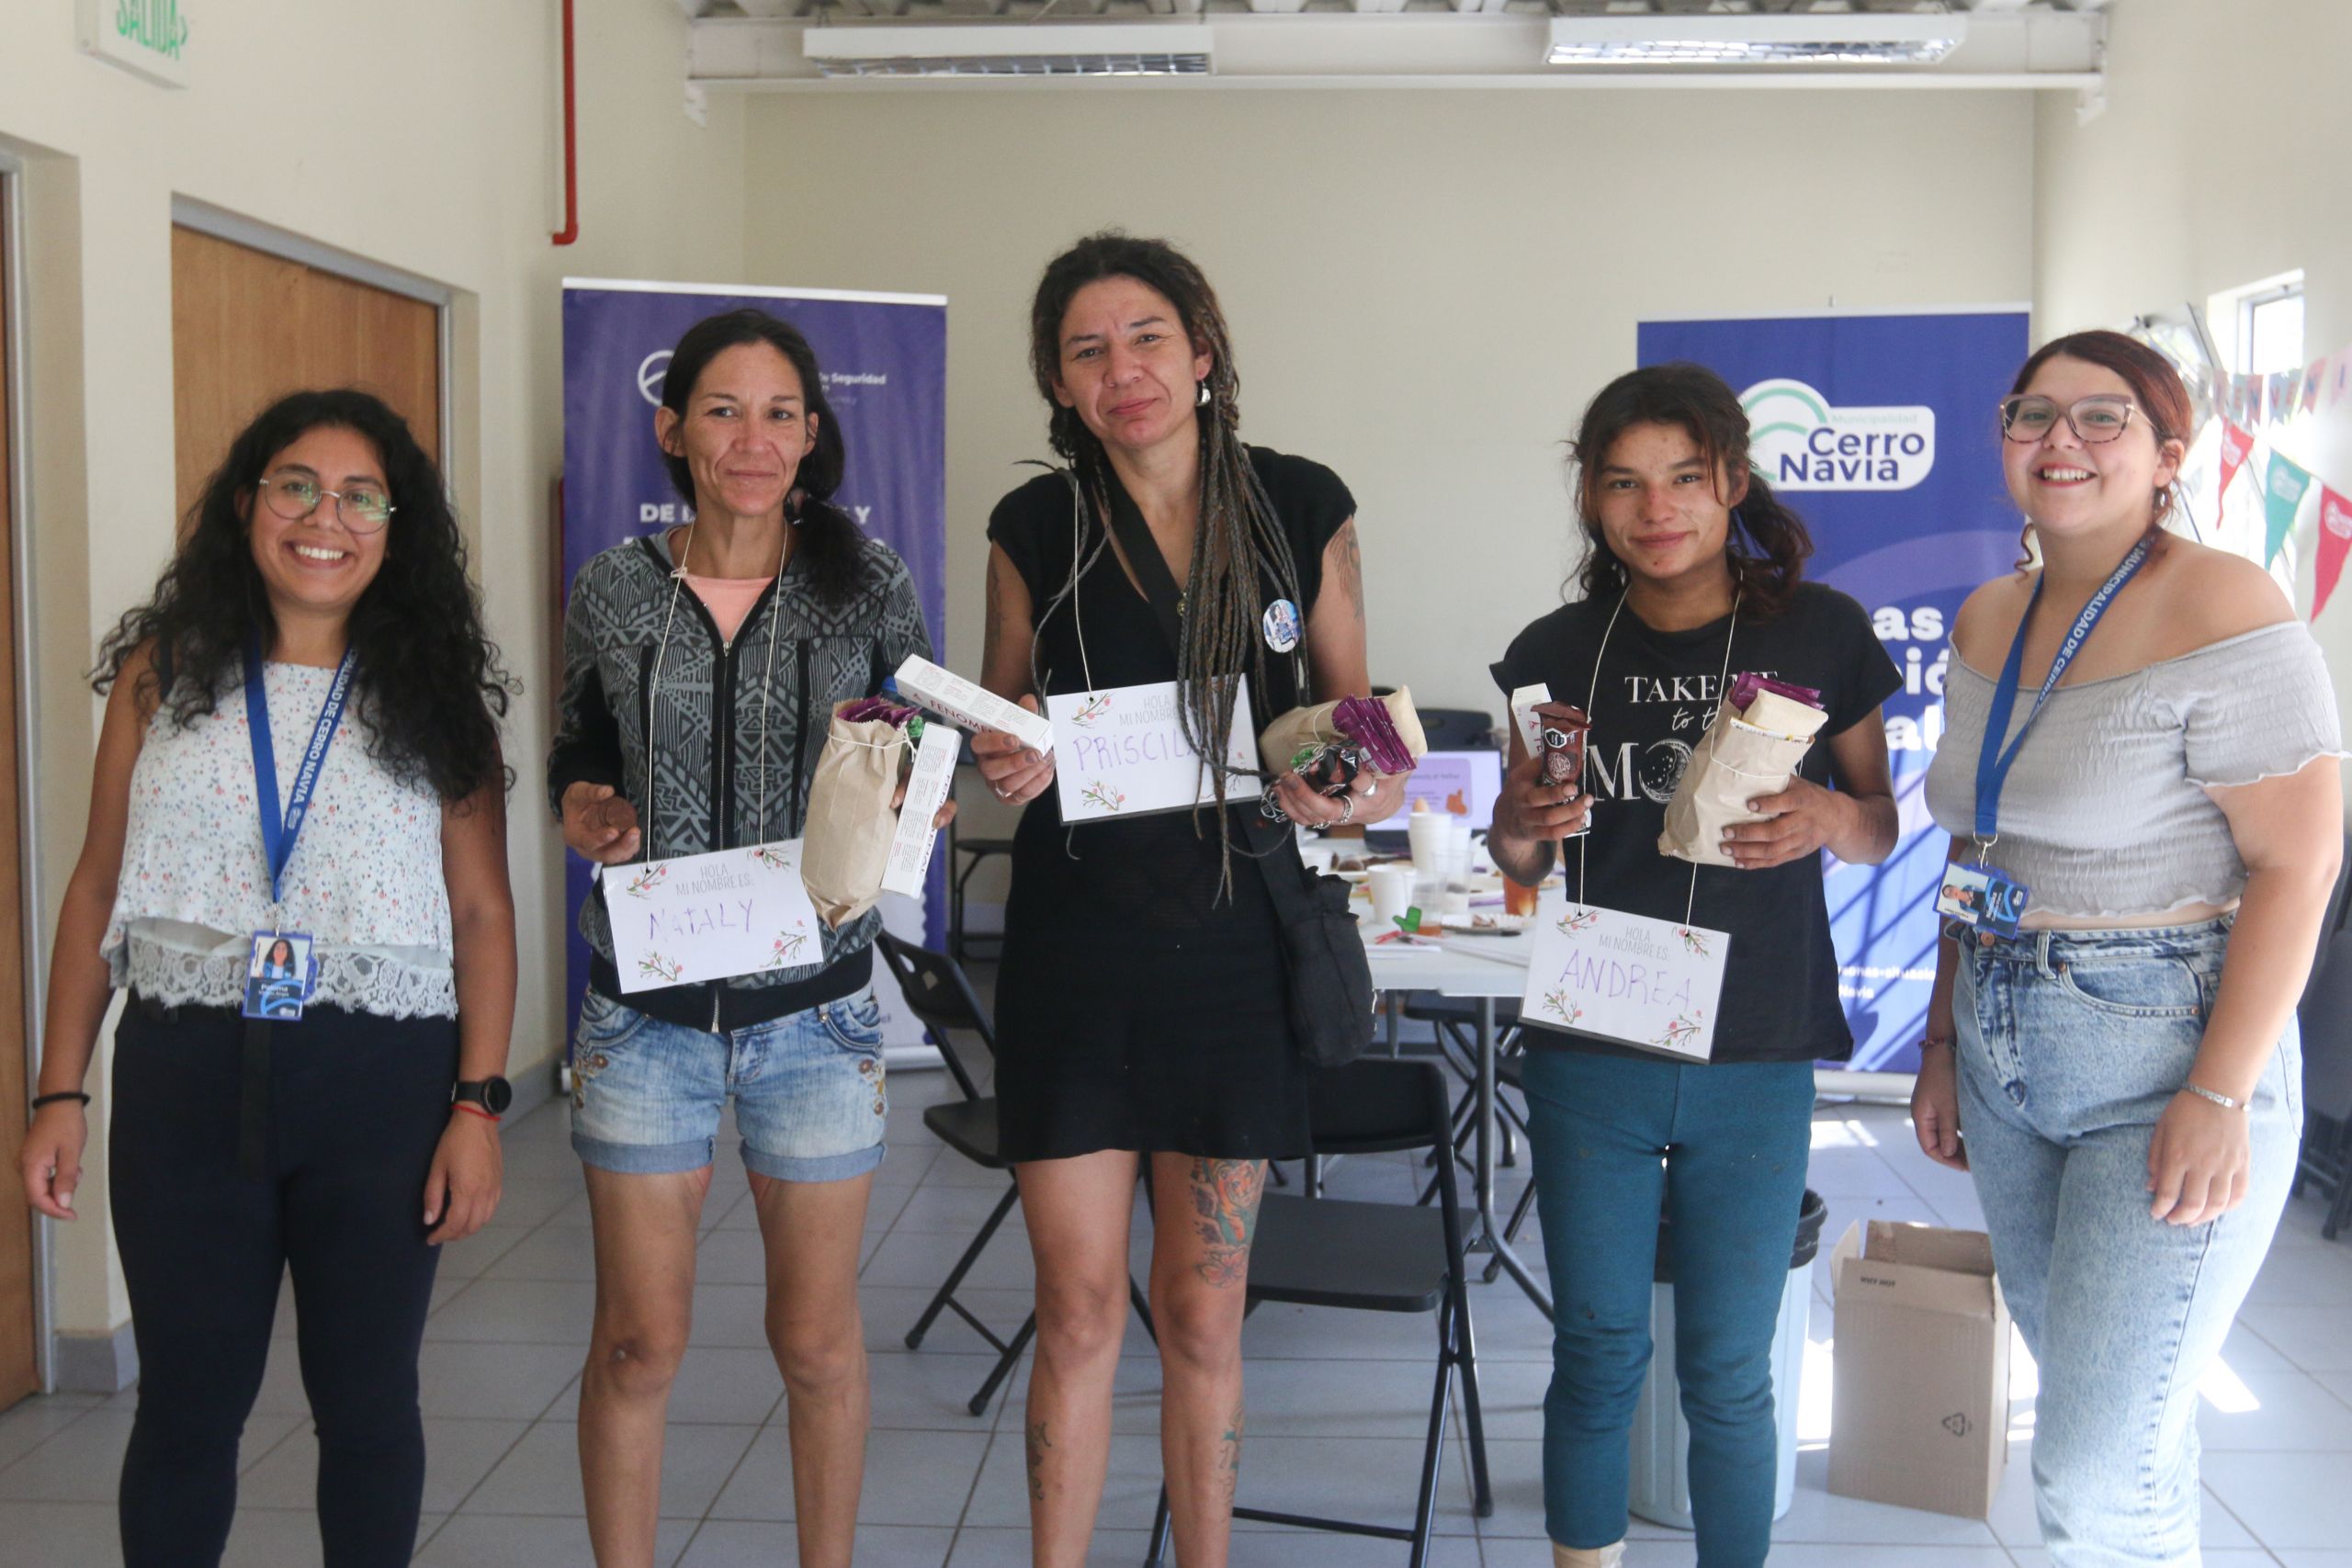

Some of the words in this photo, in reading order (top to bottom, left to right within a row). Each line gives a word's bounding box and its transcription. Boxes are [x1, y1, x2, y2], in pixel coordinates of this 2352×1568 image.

[831, 372, 888, 386] Seguridad
[1808, 427, 1926, 457] Cerro
[1781, 453, 1899, 482] Navia
[639, 503, 675, 523] DE
[2061, 638, 2079, 660] DE
[1624, 675, 1720, 703] TAKE
[324, 702, 340, 719] DE
[1144, 694, 1170, 709] HOLA
[931, 699, 993, 734] FENOME
[1119, 712, 1132, 728] MI
[1671, 706, 1694, 731] to
[309, 717, 332, 761] CERRO
[293, 760, 317, 805] NAVIA
[699, 863, 729, 878] HOLA
[675, 881, 689, 897] MI
[692, 875, 736, 894] NOMBRE
[650, 898, 753, 942] NATALY
[1625, 926, 1651, 942] HOLA
[1612, 936, 1655, 957] NOMBRE
[1559, 949, 1691, 1011] ANDREA
